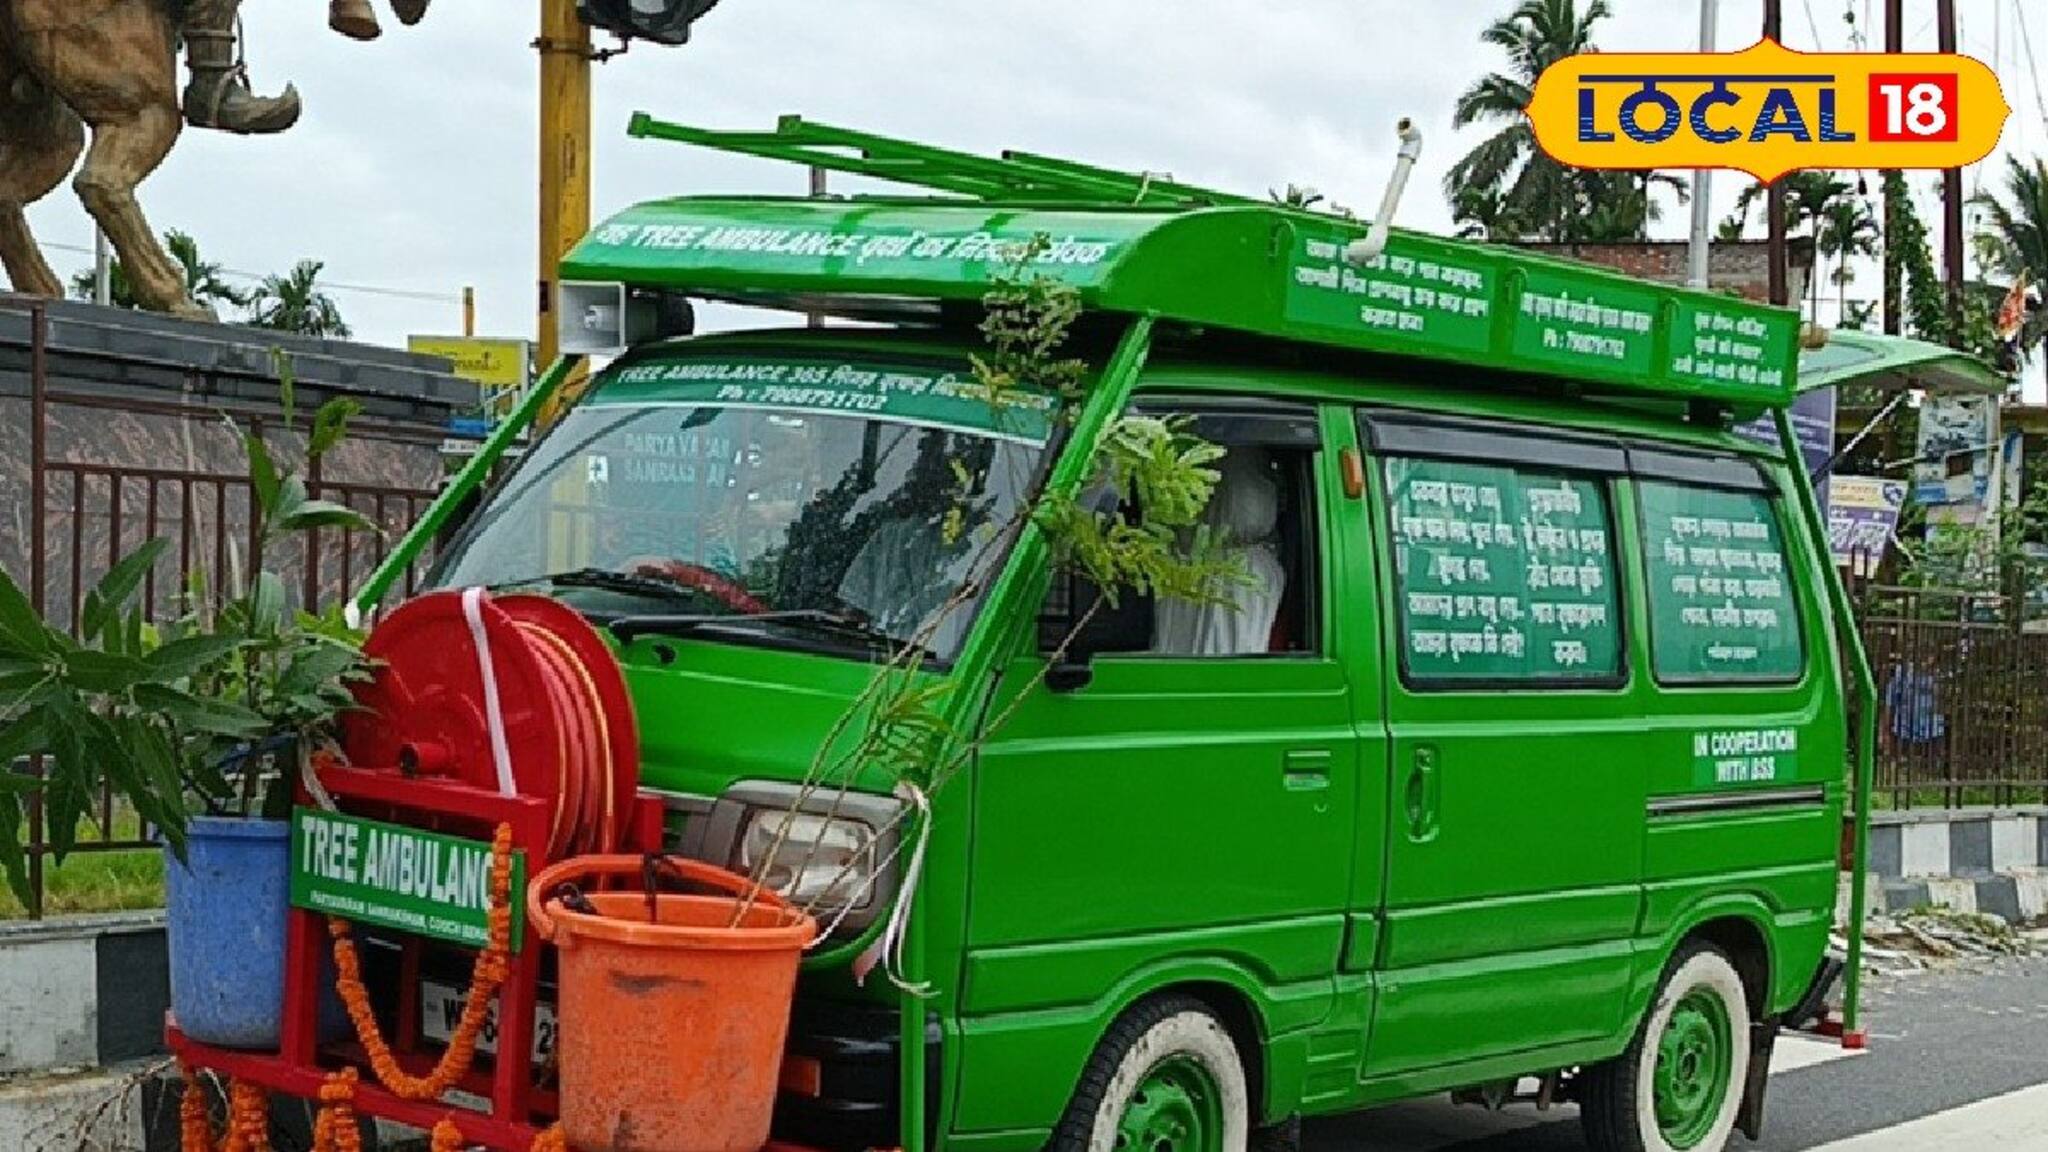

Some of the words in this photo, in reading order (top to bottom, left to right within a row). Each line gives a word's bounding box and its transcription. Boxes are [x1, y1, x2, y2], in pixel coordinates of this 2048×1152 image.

[633, 224, 705, 249] TREE
[693, 227, 862, 256] AMBULANCE
[617, 365, 668, 383] TREE
[662, 364, 789, 381] AMBULANCE
[1694, 732, 1708, 756] IN
[1715, 760, 1748, 781] WITH
[301, 815, 359, 883] TREE
[362, 827, 513, 915] AMBULANC
